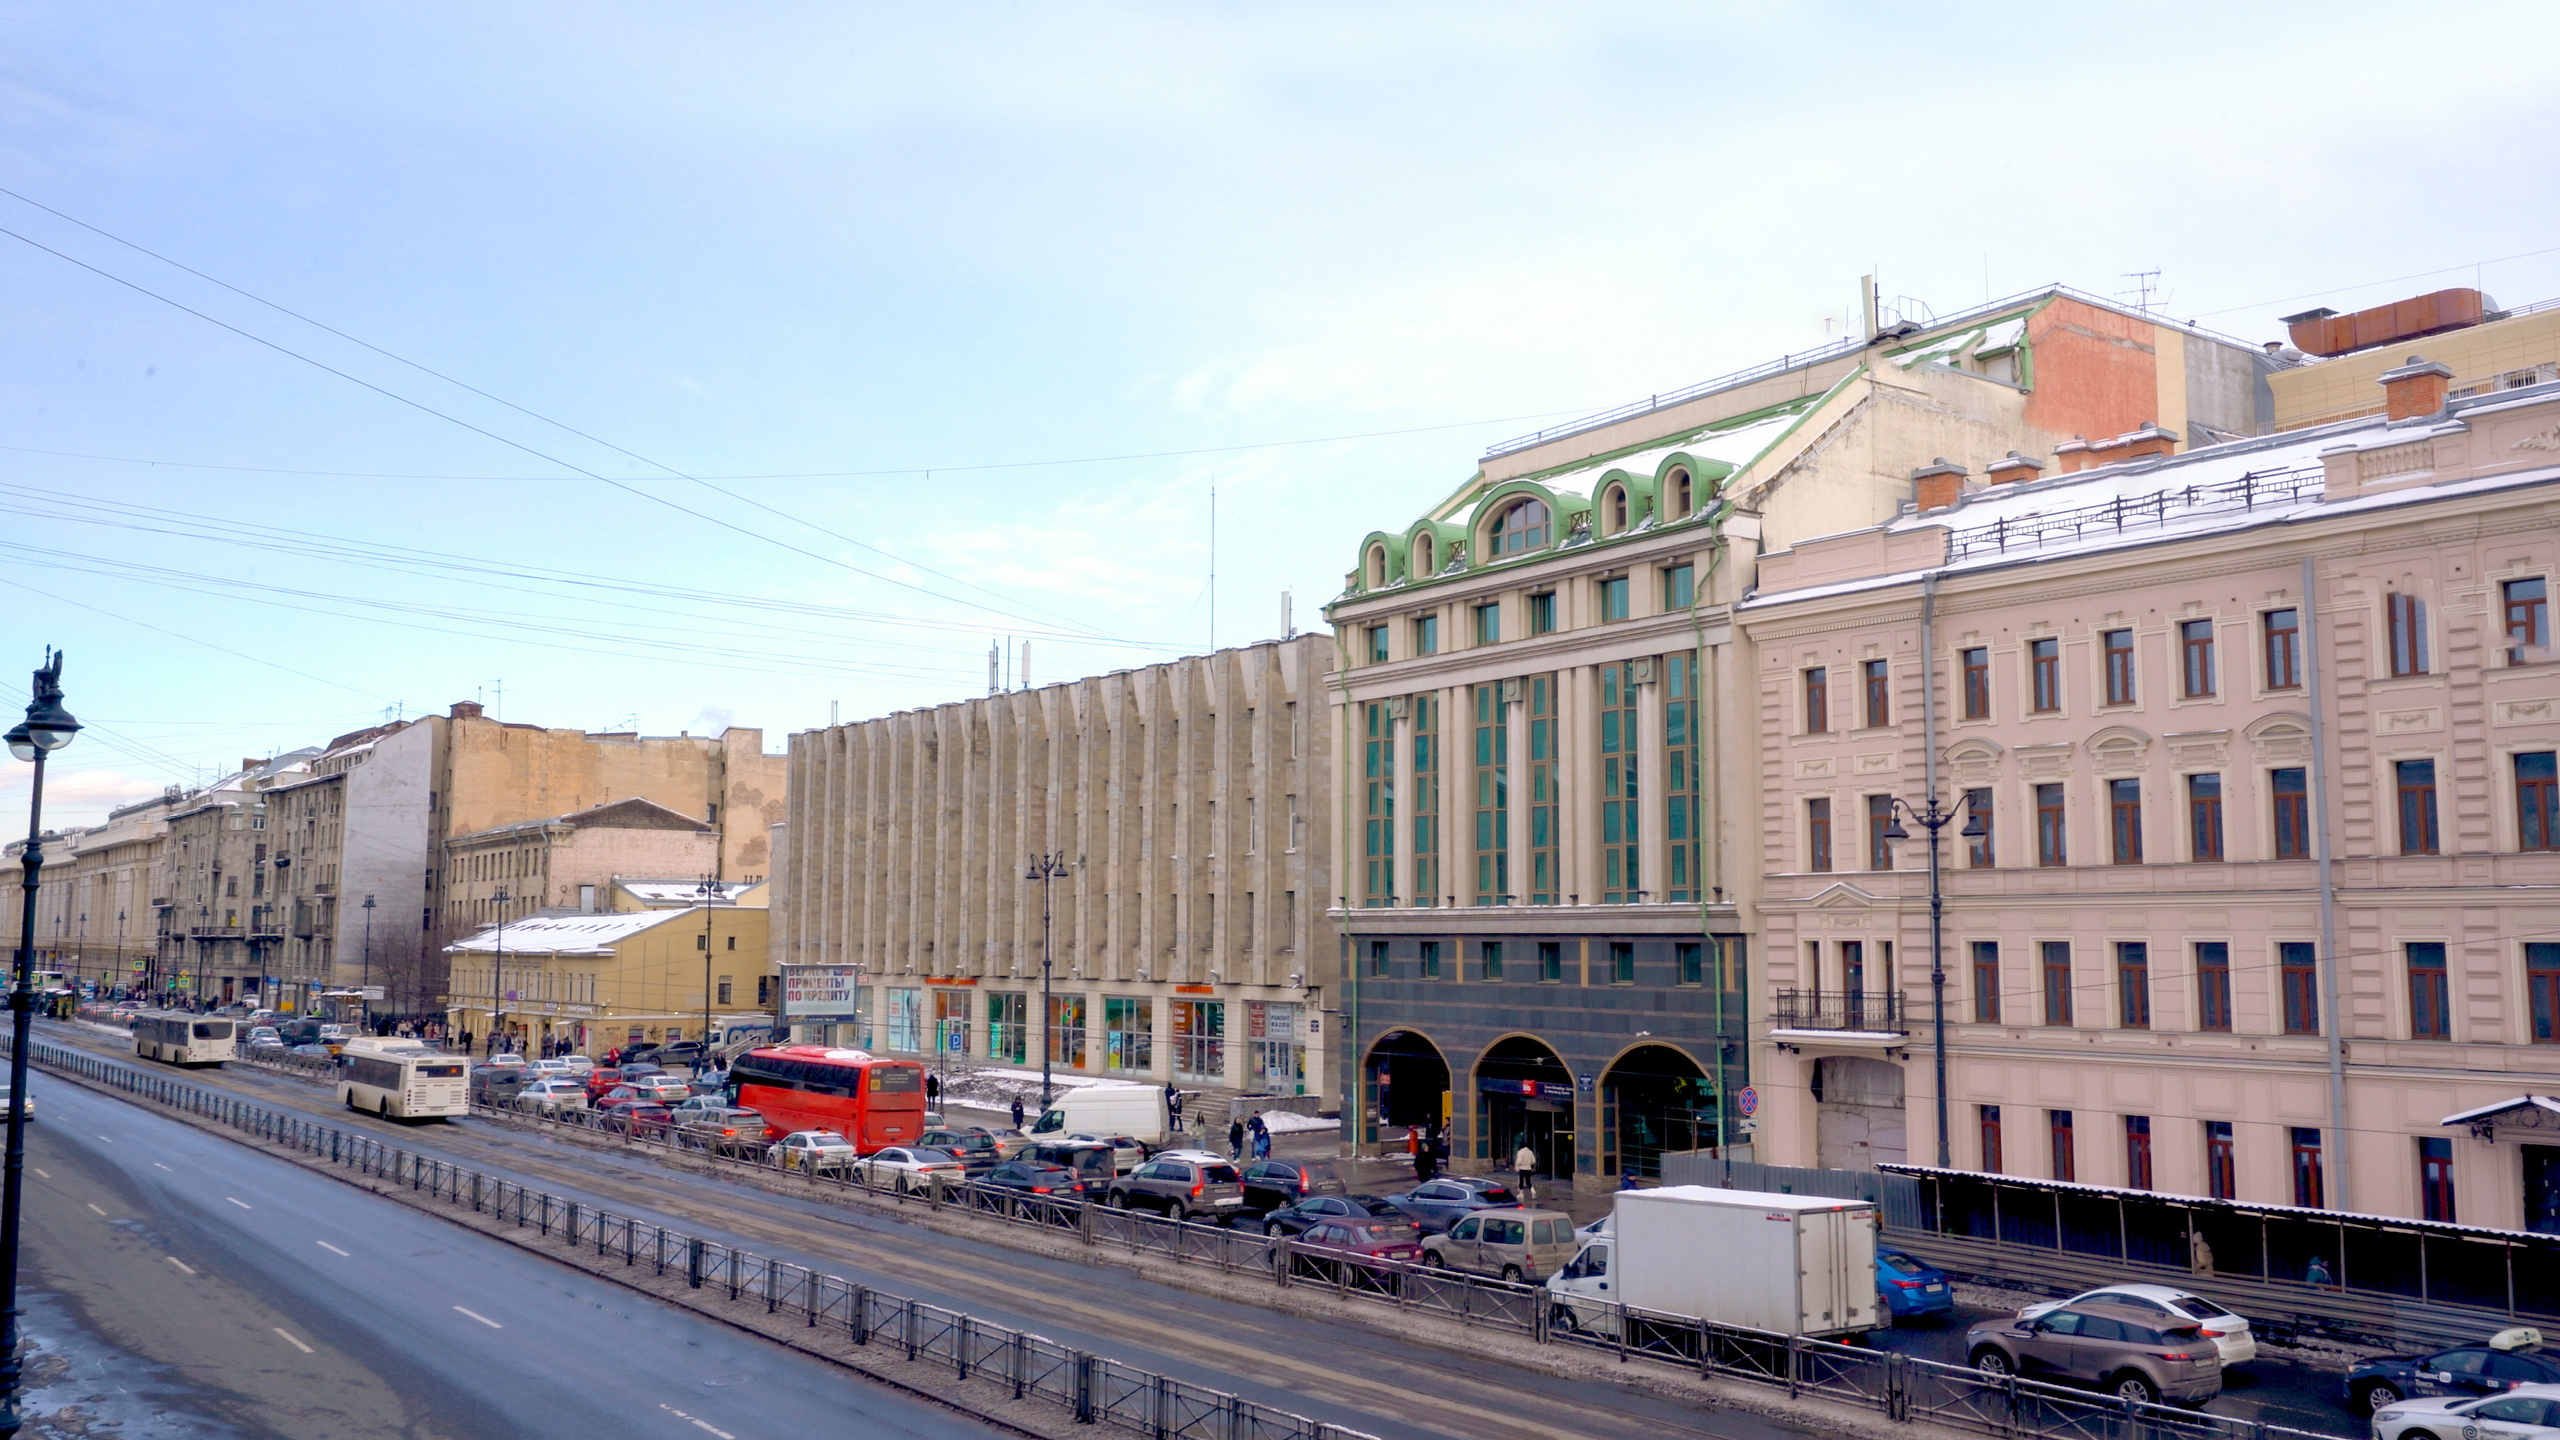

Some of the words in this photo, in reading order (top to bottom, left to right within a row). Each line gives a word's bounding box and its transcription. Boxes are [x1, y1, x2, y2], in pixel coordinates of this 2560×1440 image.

[788, 978, 844, 988] ПРОЦЕНТЫ
[788, 990, 802, 1001] ПО
[805, 990, 850, 1002] КРЕДИТУ
[2415, 1370, 2439, 1380] Яндекс
[2480, 1426, 2510, 1437] Яндекс
